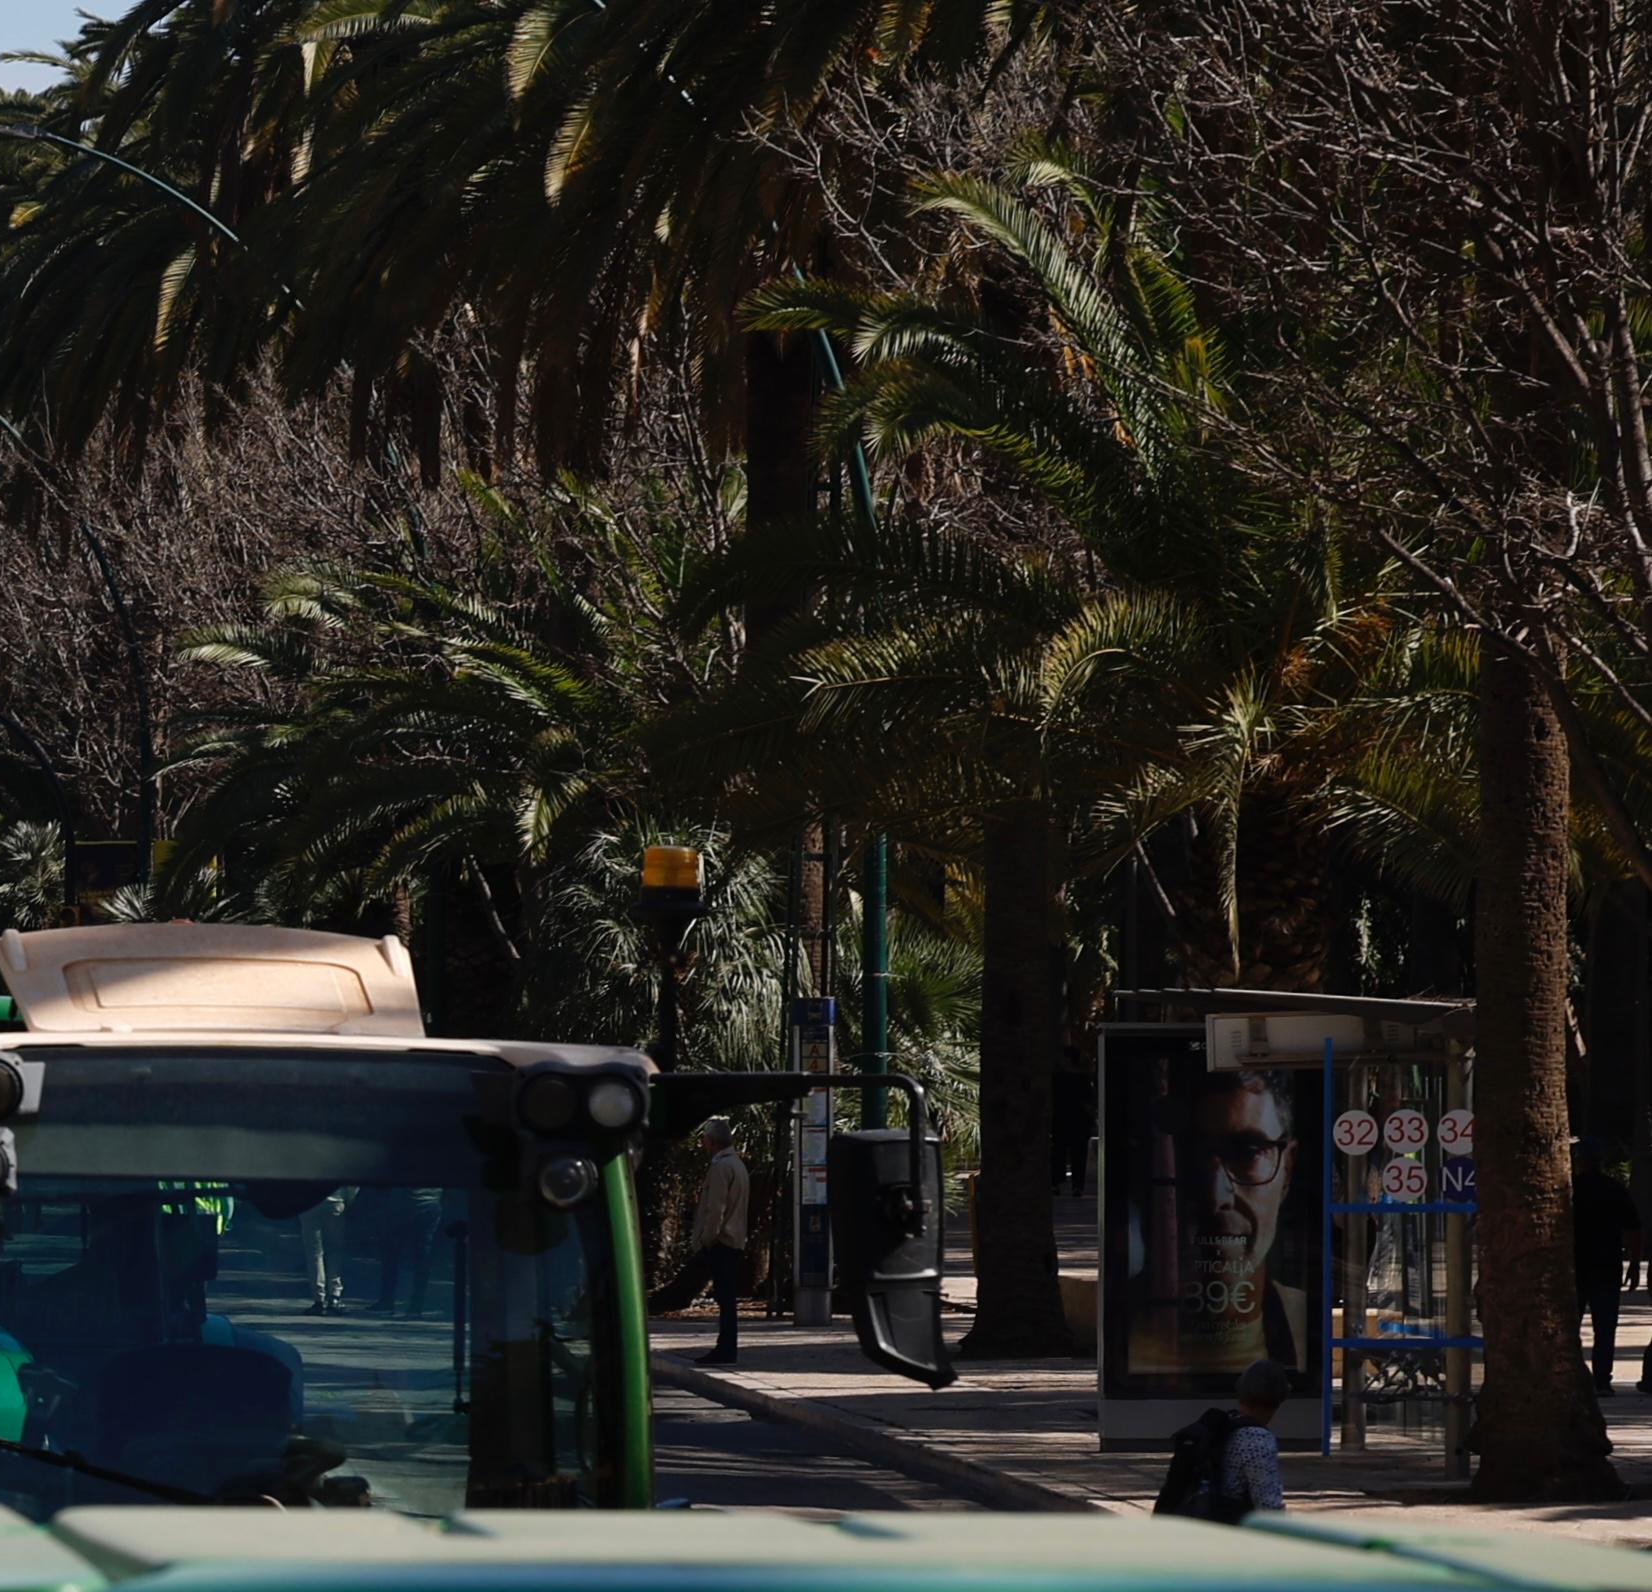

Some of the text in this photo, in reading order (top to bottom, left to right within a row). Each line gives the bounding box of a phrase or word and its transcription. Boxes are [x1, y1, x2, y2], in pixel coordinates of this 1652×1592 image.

[1337, 1119, 1374, 1146] 32
[1387, 1116, 1425, 1143] 33
[1385, 1165, 1425, 1193] 35
